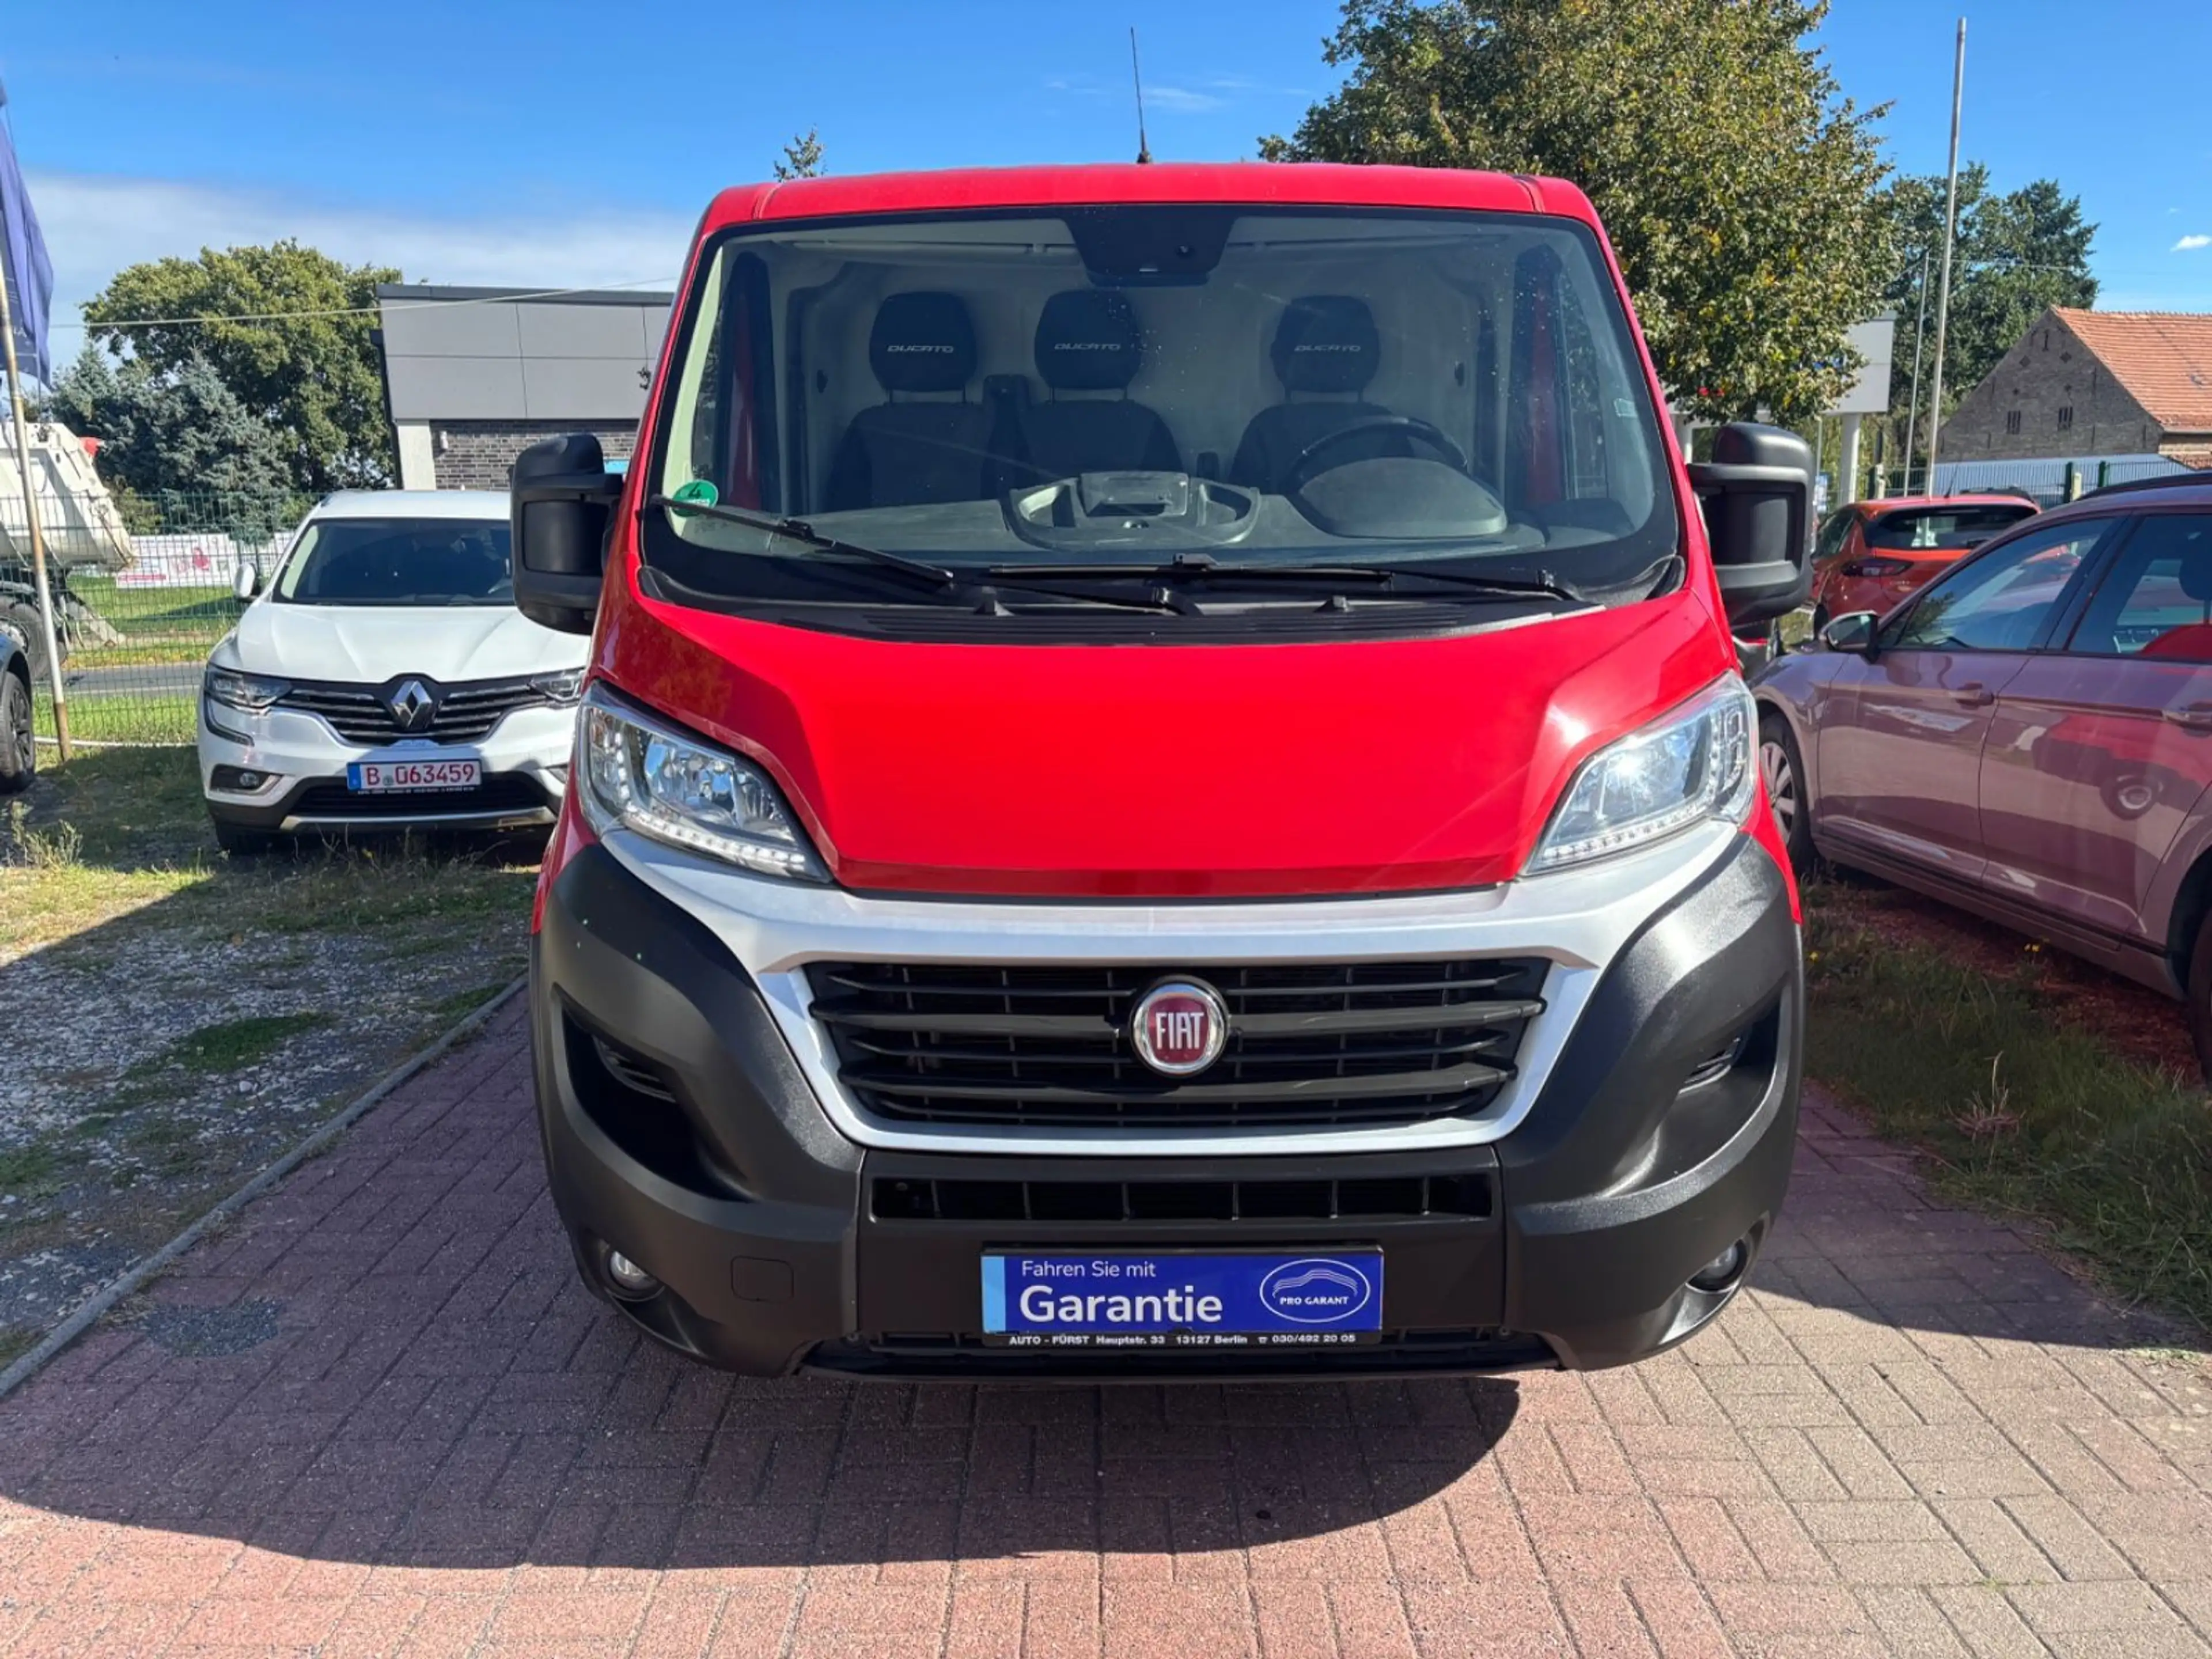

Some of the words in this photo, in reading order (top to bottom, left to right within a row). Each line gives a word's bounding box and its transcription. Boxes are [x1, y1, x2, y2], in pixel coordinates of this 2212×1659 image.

[887, 345, 954, 353] DUCATO
[688, 483, 701, 498] 4
[366, 767, 380, 785] B
[395, 763, 474, 784] 063459
[1156, 1012, 1204, 1049] FIAT
[1021, 1260, 1085, 1277] Fahren
[1092, 1260, 1119, 1277] Sie
[1126, 1261, 1156, 1277] mit
[1020, 1285, 1222, 1322] Garantie
[1305, 1297, 1349, 1305] GARANT
[1009, 1336, 1041, 1344] AUTO
[1052, 1335, 1089, 1344] FÜRST
[1096, 1336, 1147, 1346] Hauptstr.
[1150, 1336, 1165, 1344] 33
[1176, 1336, 1210, 1344] 13127
[1271, 1334, 1319, 1343] 030/492
[1323, 1335, 1338, 1343] 20
